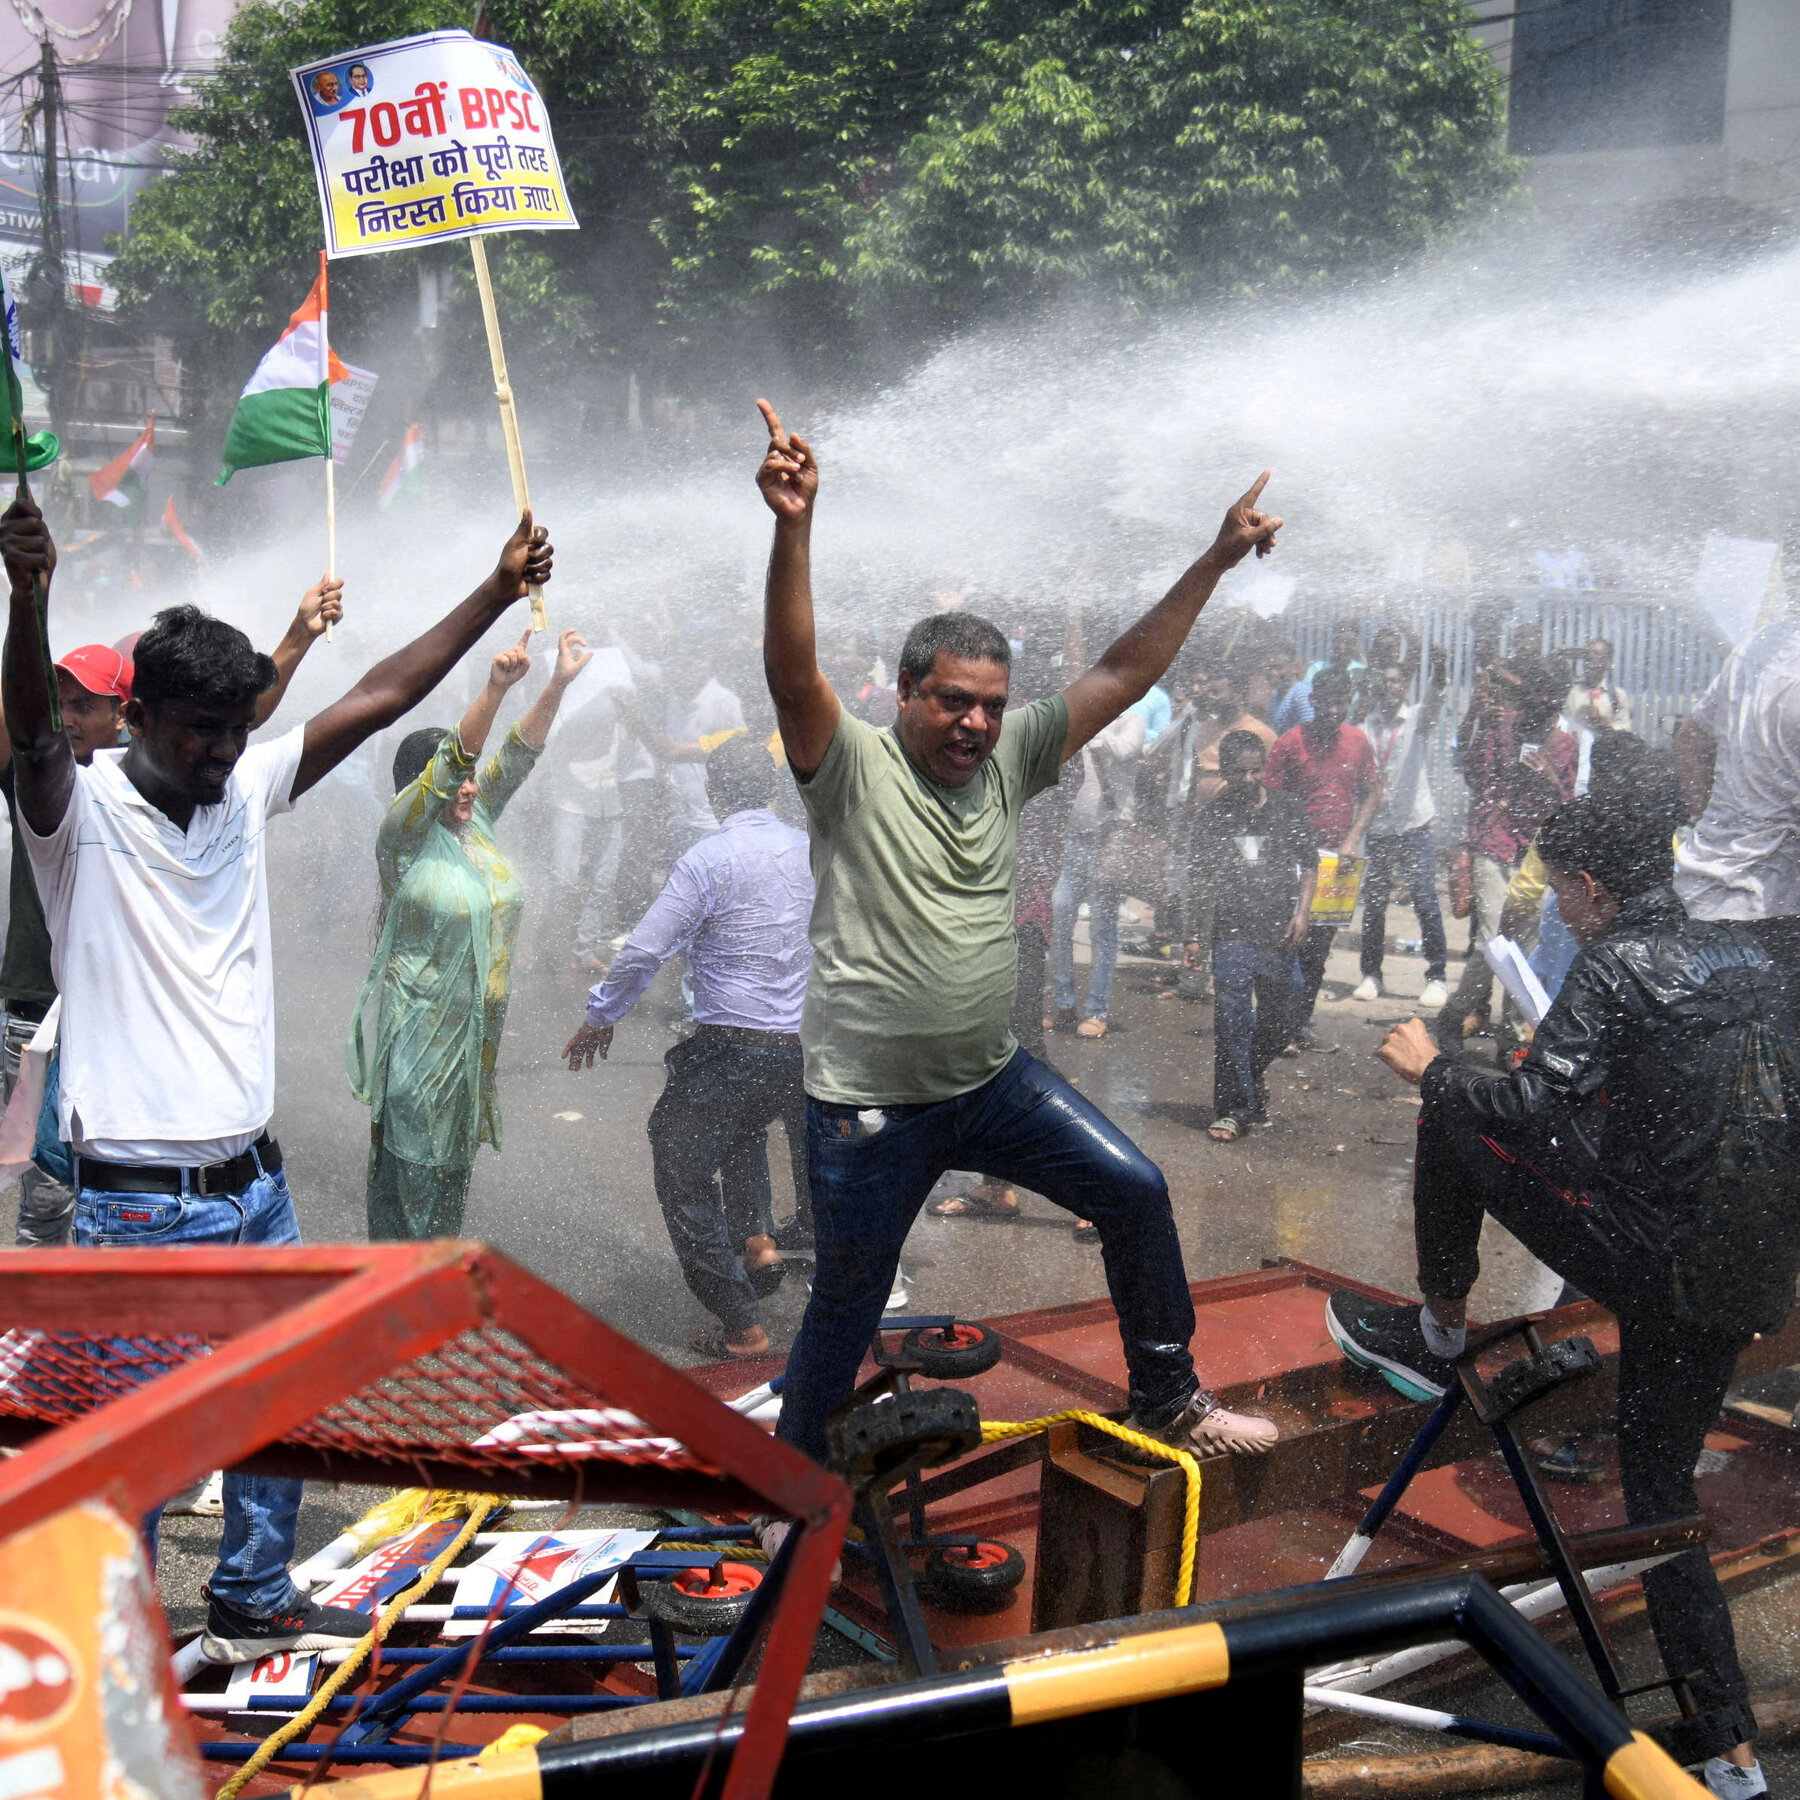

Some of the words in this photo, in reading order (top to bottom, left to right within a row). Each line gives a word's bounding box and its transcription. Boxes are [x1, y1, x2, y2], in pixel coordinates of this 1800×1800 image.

[339, 81, 448, 154] 70वीं
[458, 87, 541, 133] BPSC
[342, 154, 426, 196] परीक्षा
[429, 139, 468, 178] को
[473, 135, 513, 180] पूरी
[515, 144, 549, 173] तरह
[355, 194, 446, 237] निरस्त
[452, 181, 517, 218] किया
